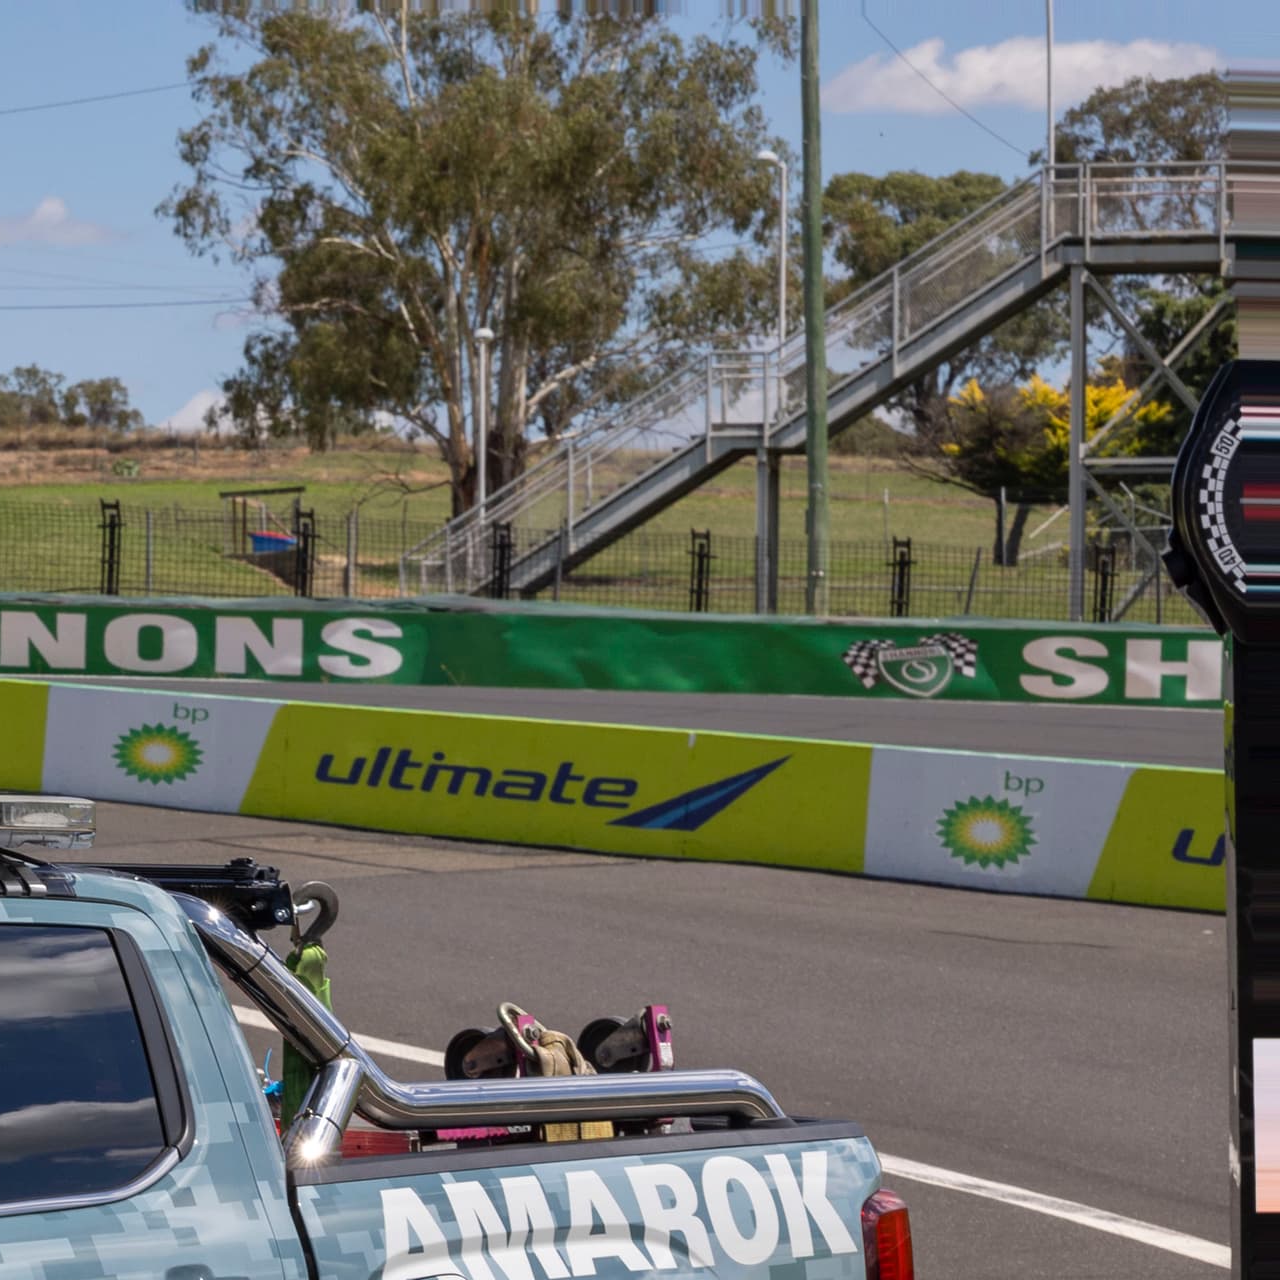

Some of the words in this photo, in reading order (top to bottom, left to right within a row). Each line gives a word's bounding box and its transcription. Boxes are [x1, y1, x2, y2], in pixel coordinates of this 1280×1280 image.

[173, 703, 209, 724] bp
[315, 747, 639, 809] ultimate
[1003, 770, 1045, 796] bp
